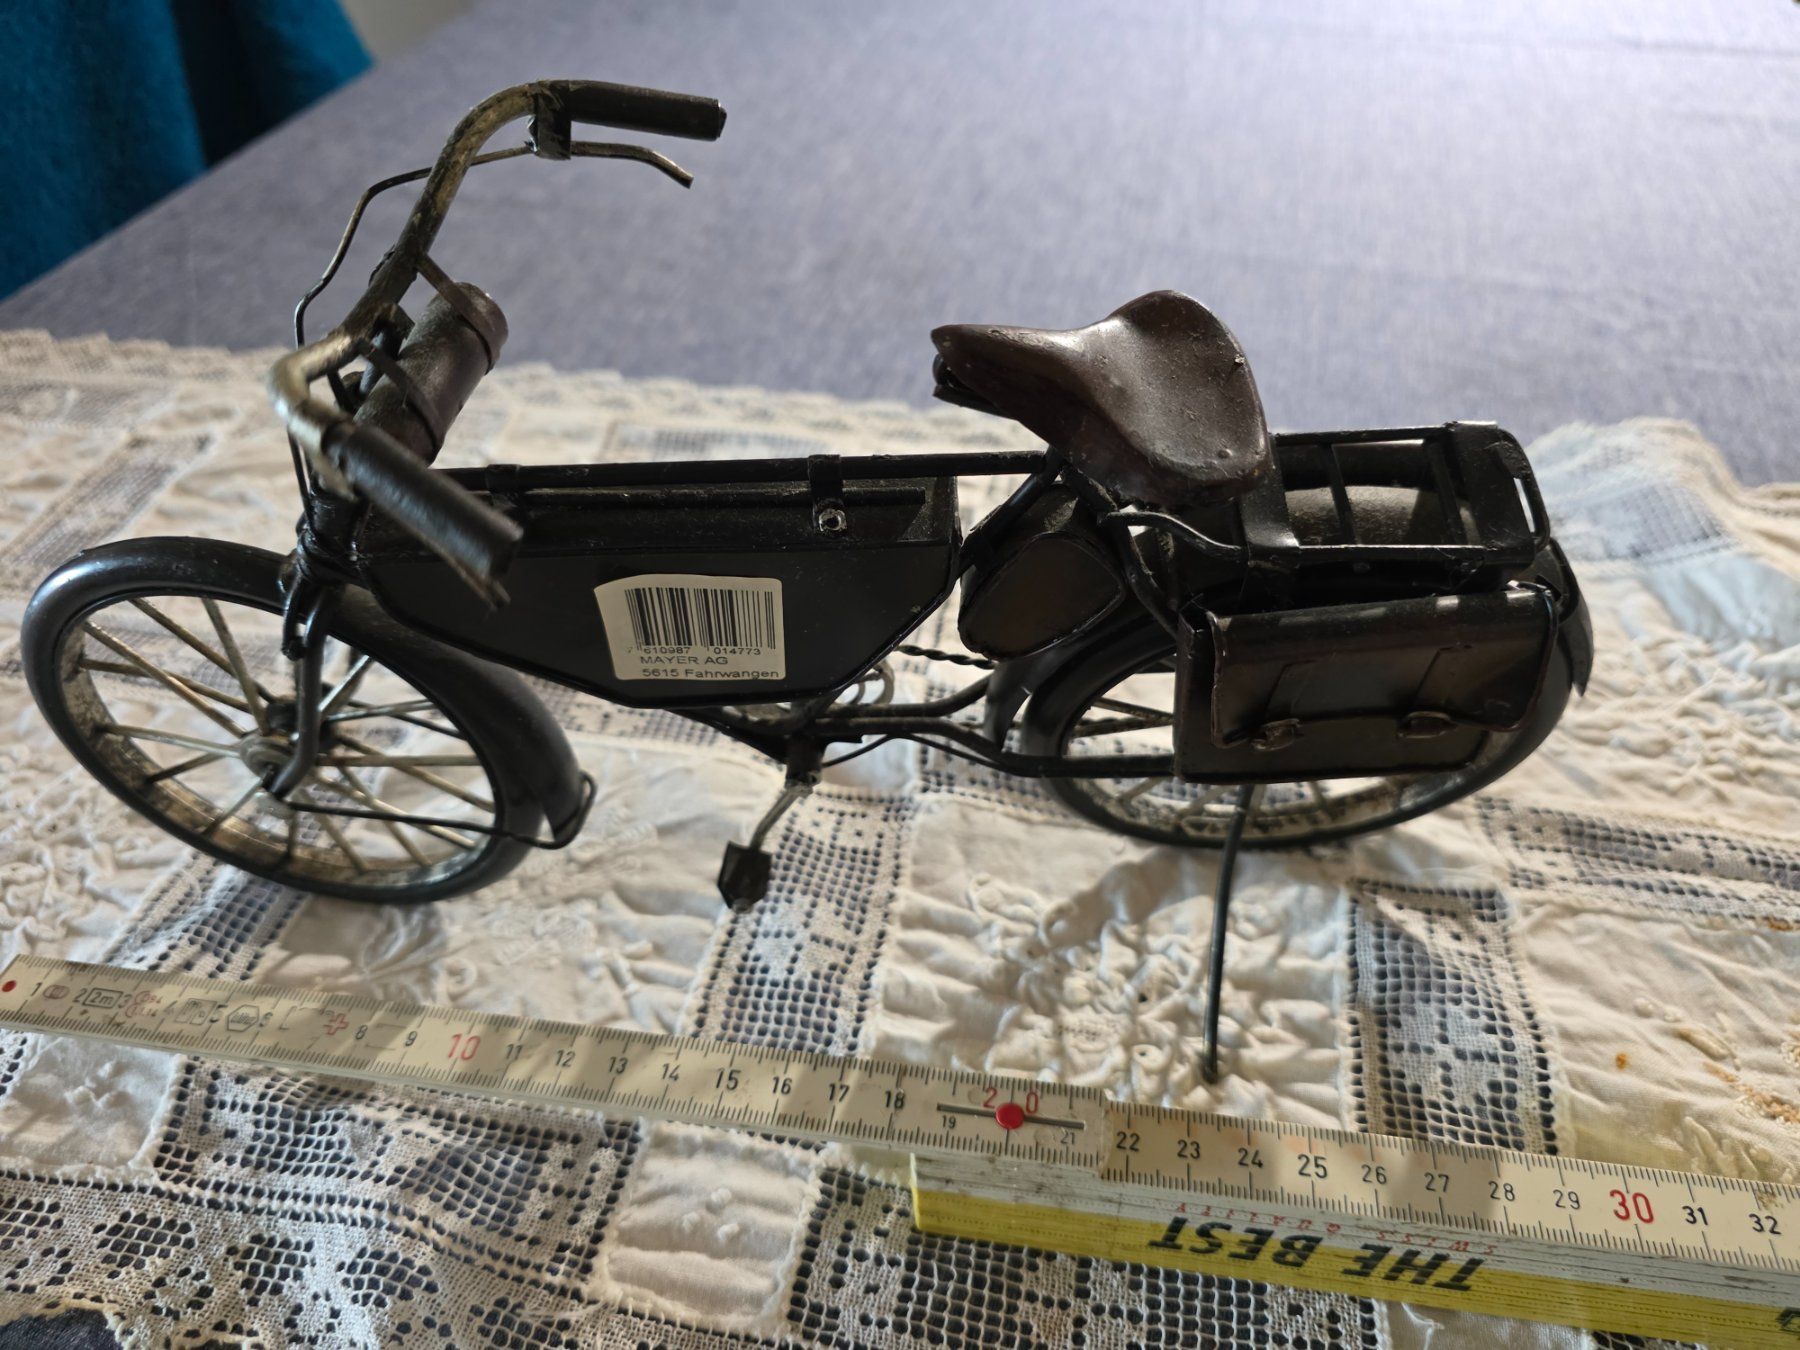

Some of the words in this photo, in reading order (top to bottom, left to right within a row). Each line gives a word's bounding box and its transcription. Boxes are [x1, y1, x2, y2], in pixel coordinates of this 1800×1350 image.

[640, 656, 699, 665] MAYER
[704, 656, 728, 665] AG
[713, 647, 761, 656] 014773
[642, 668, 679, 677] 5615
[684, 669, 779, 680] Fahrwangen
[31, 982, 43, 997] 1
[72, 988, 88, 1003] 2
[355, 1024, 368, 1040] 8
[404, 1030, 418, 1047] 9
[447, 1032, 481, 1061] 10
[505, 1043, 523, 1060] 11
[554, 1049, 576, 1068] 12
[608, 1056, 628, 1074] 13
[662, 1063, 680, 1082] 14
[715, 1067, 741, 1091] 15
[772, 1076, 792, 1095] 16
[828, 1082, 850, 1102] 17
[885, 1090, 906, 1110] 18
[942, 1115, 956, 1129] 19
[1060, 1130, 1075, 1144] 21
[1116, 1131, 1140, 1151] 22
[1177, 1139, 1200, 1160] 23
[1238, 1147, 1264, 1168] 24
[1298, 1154, 1328, 1179] 25
[1361, 1164, 1387, 1185] 26
[1424, 1172, 1449, 1193] 27
[1488, 1180, 1516, 1201] 28
[1553, 1189, 1580, 1210] 29
[1609, 1189, 1654, 1224] 30
[1682, 1205, 1708, 1226] 31
[1749, 1213, 1782, 1235] 32
[1147, 1216, 1324, 1267] BEST
[1342, 1243, 1485, 1292] THE
